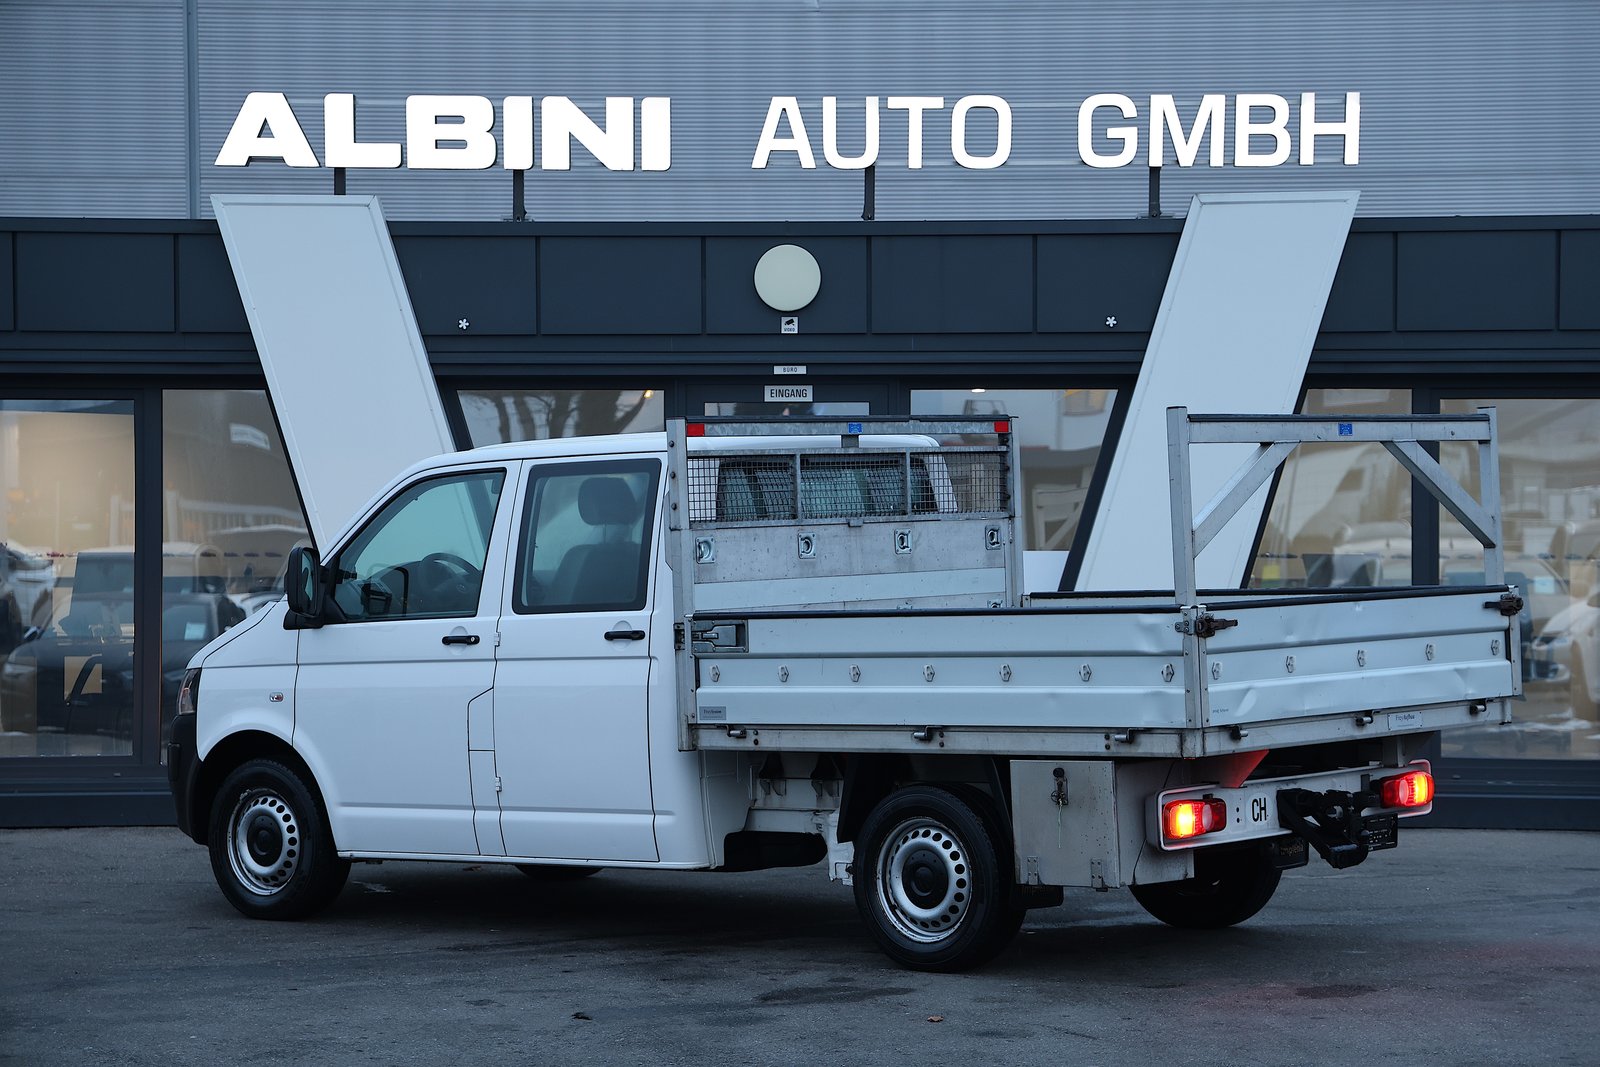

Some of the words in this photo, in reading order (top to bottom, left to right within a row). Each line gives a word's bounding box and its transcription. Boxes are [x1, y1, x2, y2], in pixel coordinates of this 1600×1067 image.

[214, 92, 672, 170] ALBINI
[752, 94, 1012, 169] AUTO
[1078, 91, 1361, 168] GMBH
[770, 388, 808, 398] EINGANG
[1252, 797, 1267, 822] CH
